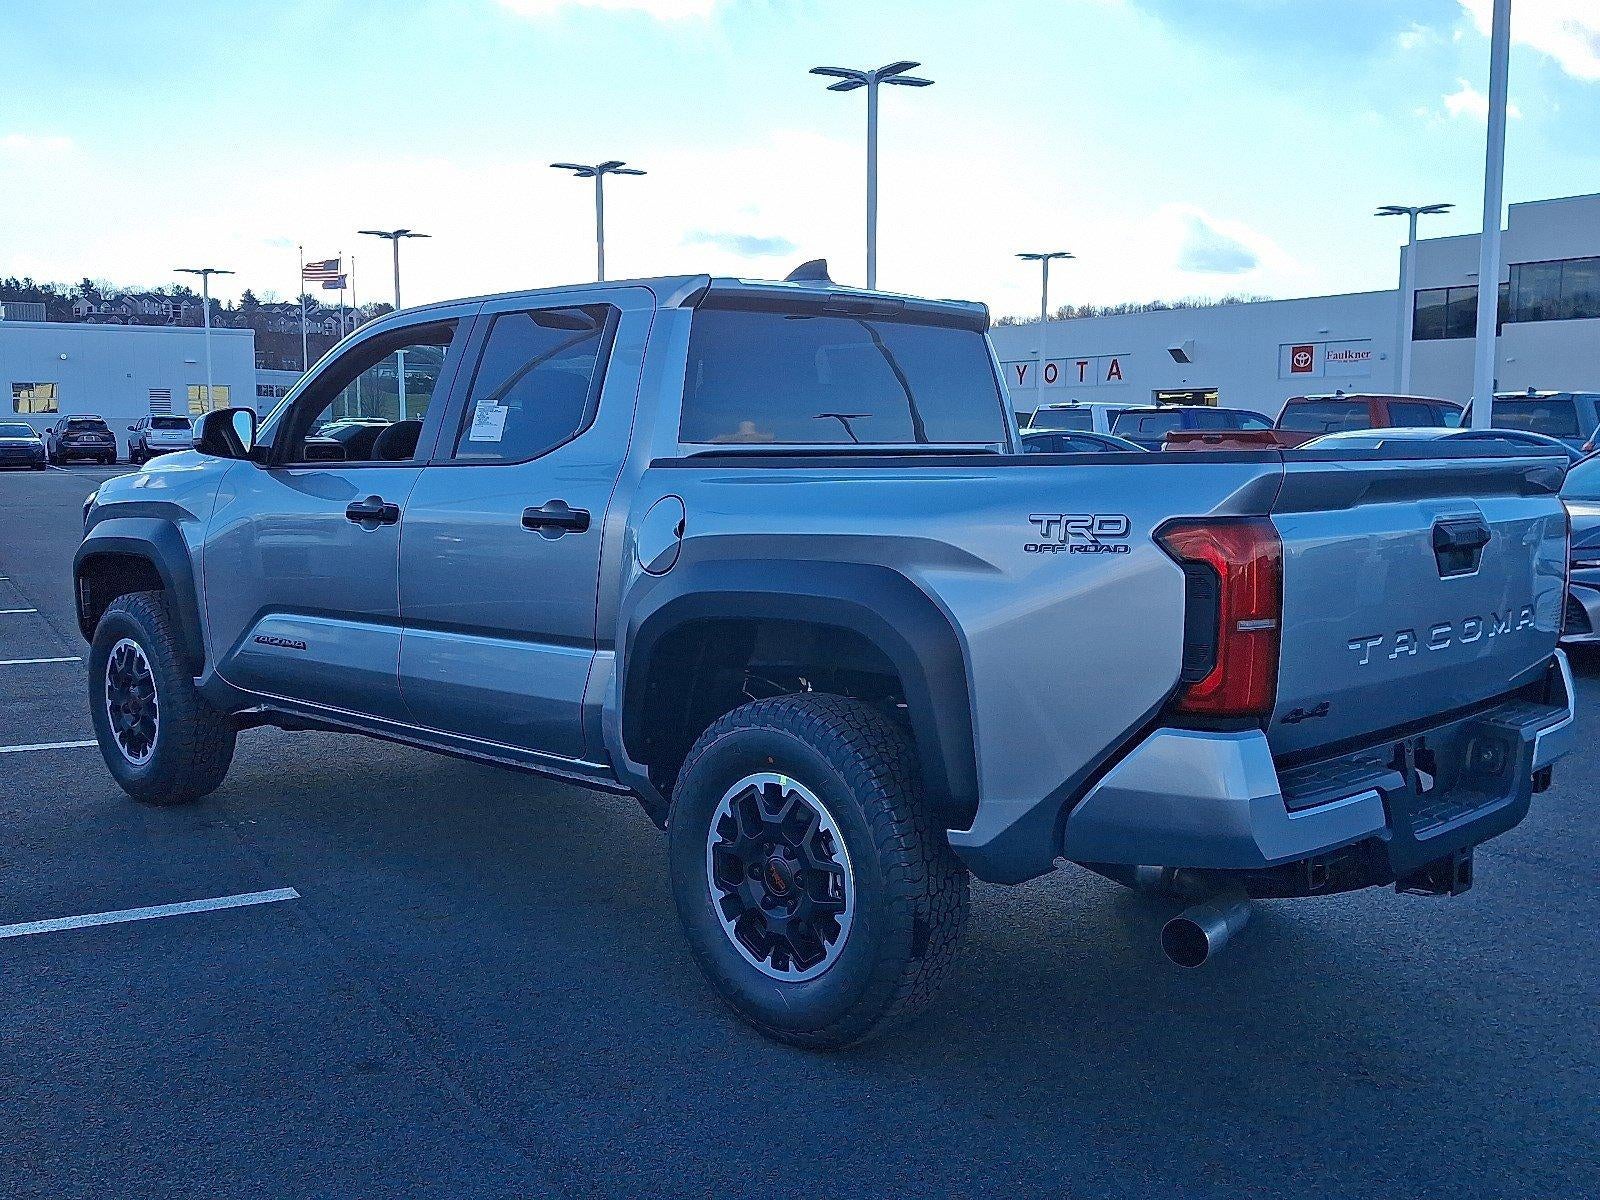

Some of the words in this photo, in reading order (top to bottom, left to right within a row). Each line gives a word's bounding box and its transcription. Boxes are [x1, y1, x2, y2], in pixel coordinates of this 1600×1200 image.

[1326, 349, 1372, 360] Faulkner
[1028, 513, 1132, 546] TRD
[1023, 543, 1068, 555] OFF
[1069, 543, 1132, 555] ROAD
[1347, 604, 1536, 666] TACOMA
